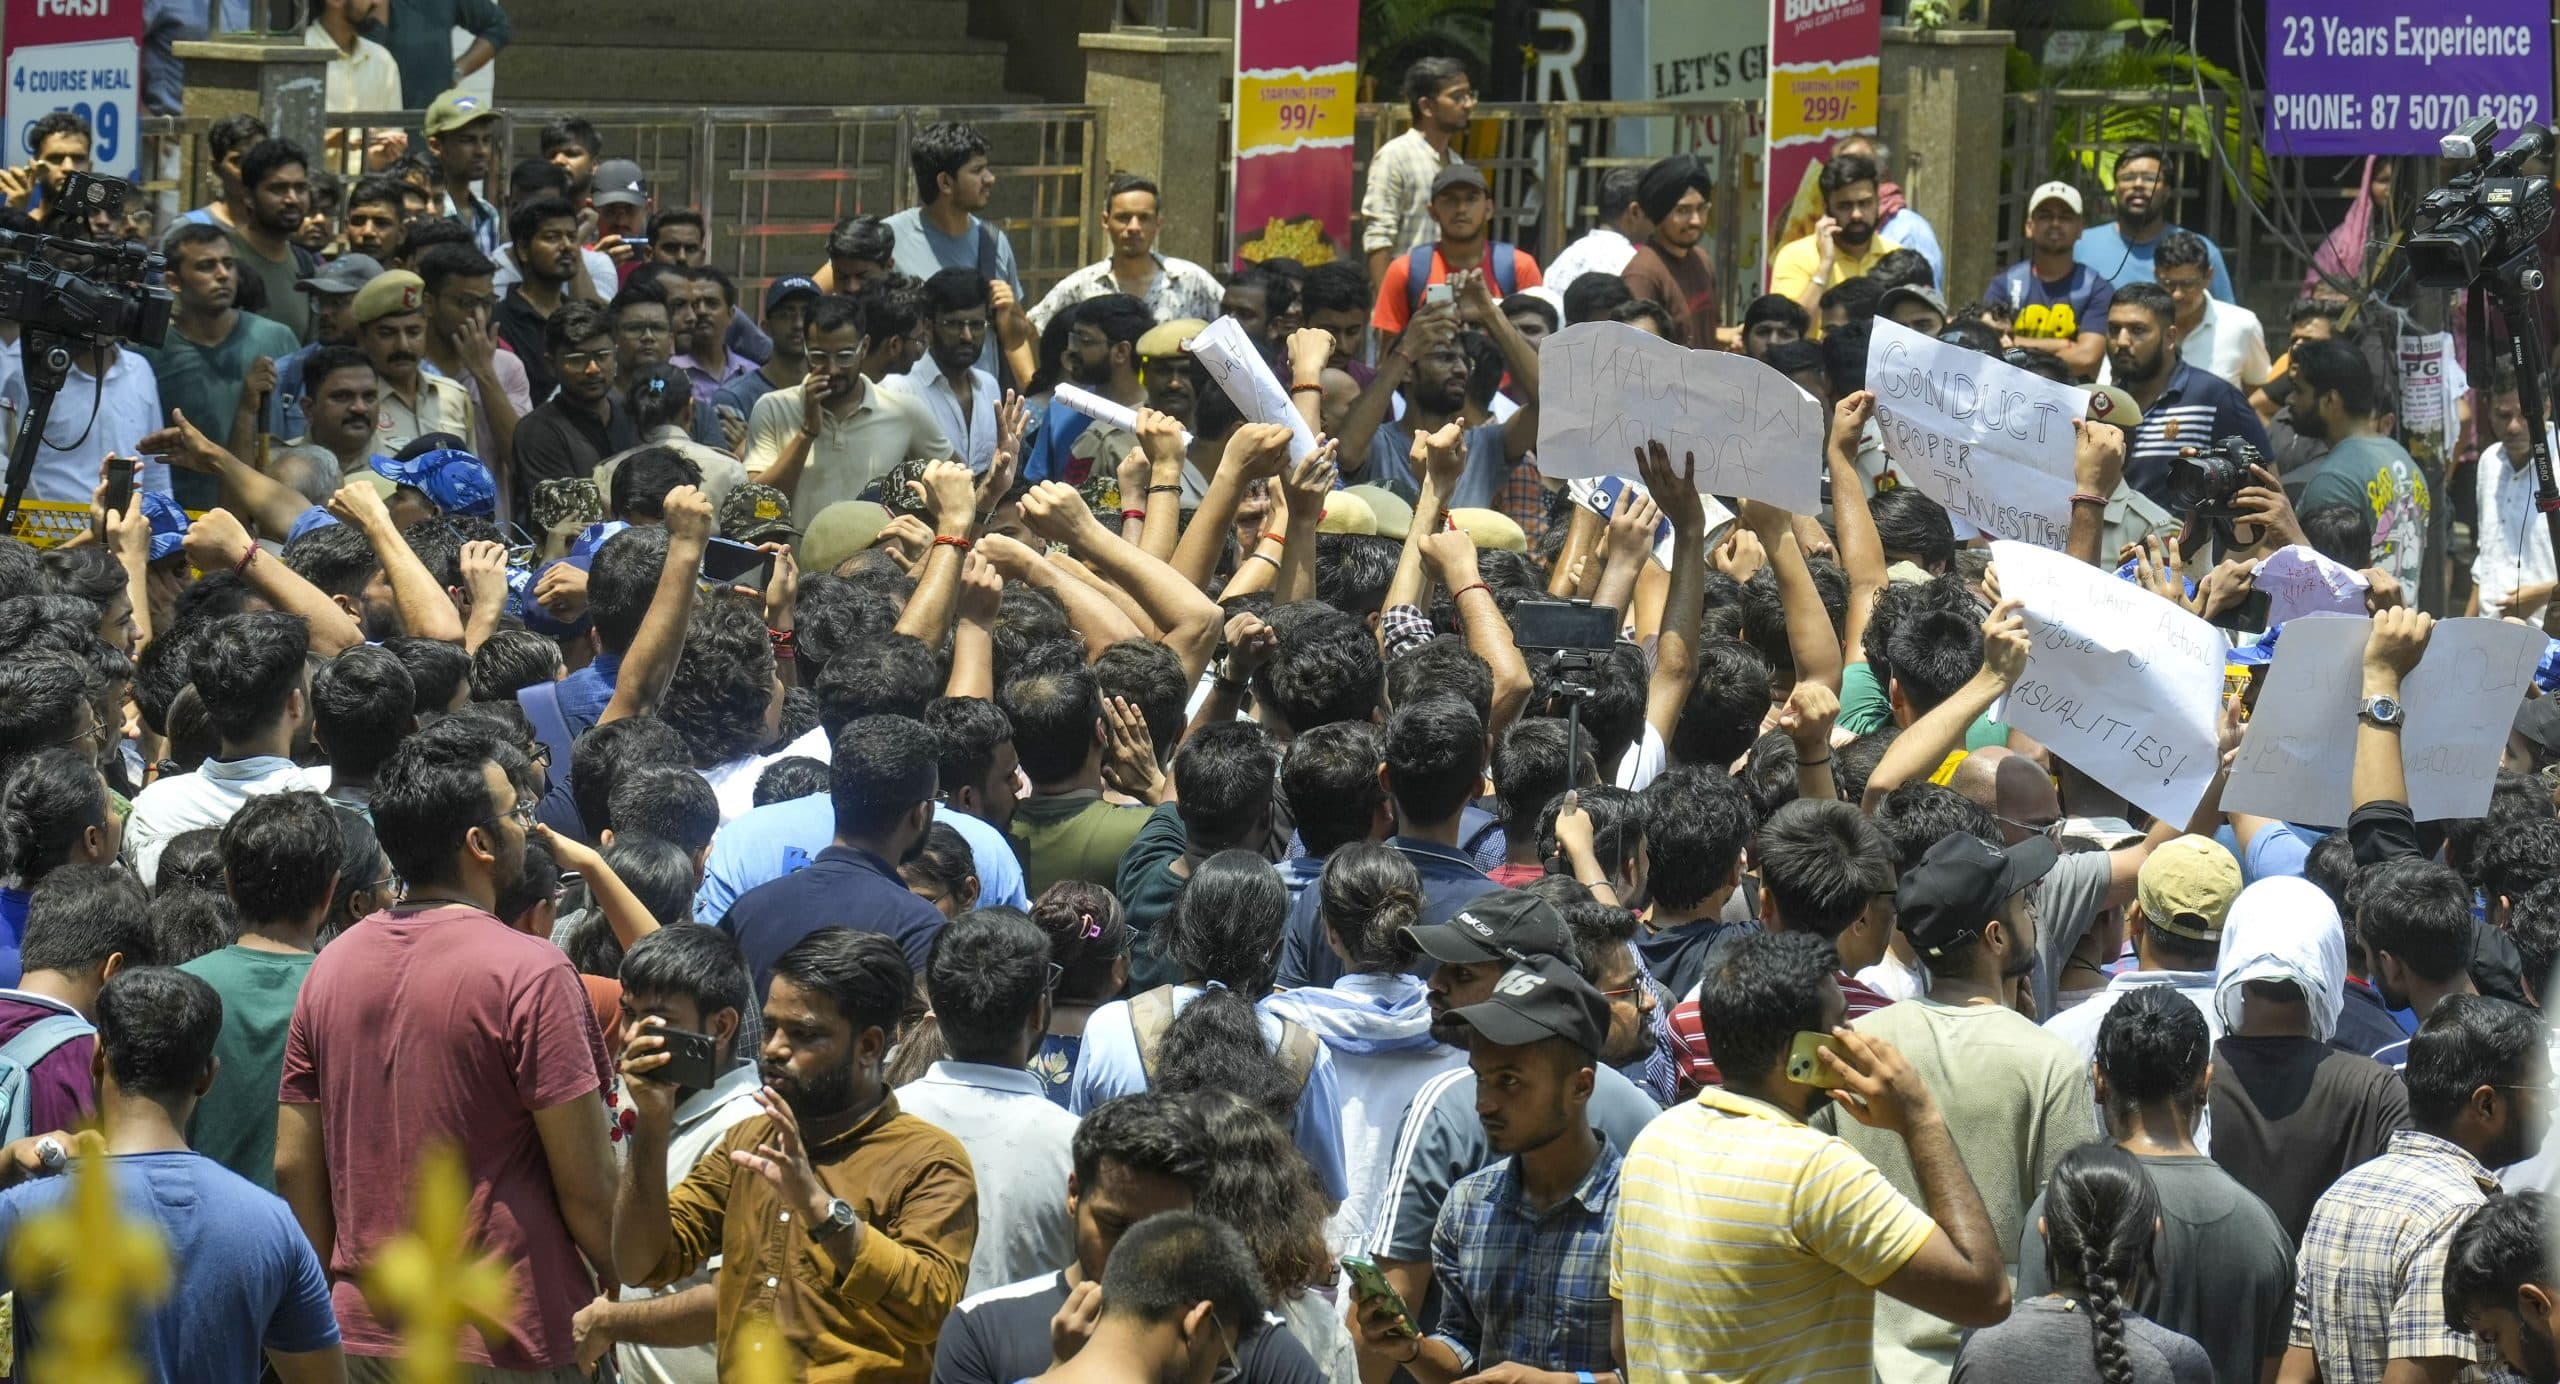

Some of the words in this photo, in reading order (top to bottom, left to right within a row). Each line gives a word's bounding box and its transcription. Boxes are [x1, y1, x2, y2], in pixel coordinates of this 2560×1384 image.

[2282, 16, 2315, 56] 23
[2321, 16, 2388, 56] Years
[2395, 14, 2531, 65] Experience
[14, 66, 25, 92] 4
[30, 70, 87, 92] COURSE
[91, 68, 131, 90] MEAL
[1654, 51, 1731, 99] LET'S
[1791, 80, 1832, 94] STARTING
[1836, 79, 1860, 91] FROM
[1260, 87, 1307, 102] STARTING
[1309, 86, 1336, 98] FROM
[1803, 95, 1857, 123] 299/-
[2274, 94, 2362, 130] PHONE:
[2370, 94, 2401, 130] 87
[2409, 94, 2470, 130] 5070
[2477, 94, 2539, 130] 6262
[1280, 103, 1326, 131] 99/-
[2405, 361, 2440, 377] PG
[1879, 340, 2059, 443] CONDUCT
[1878, 404, 1973, 478] PROPER
[1933, 469, 2071, 552] INVESTIGA
[2008, 657, 2188, 786] ASUALITIES!
